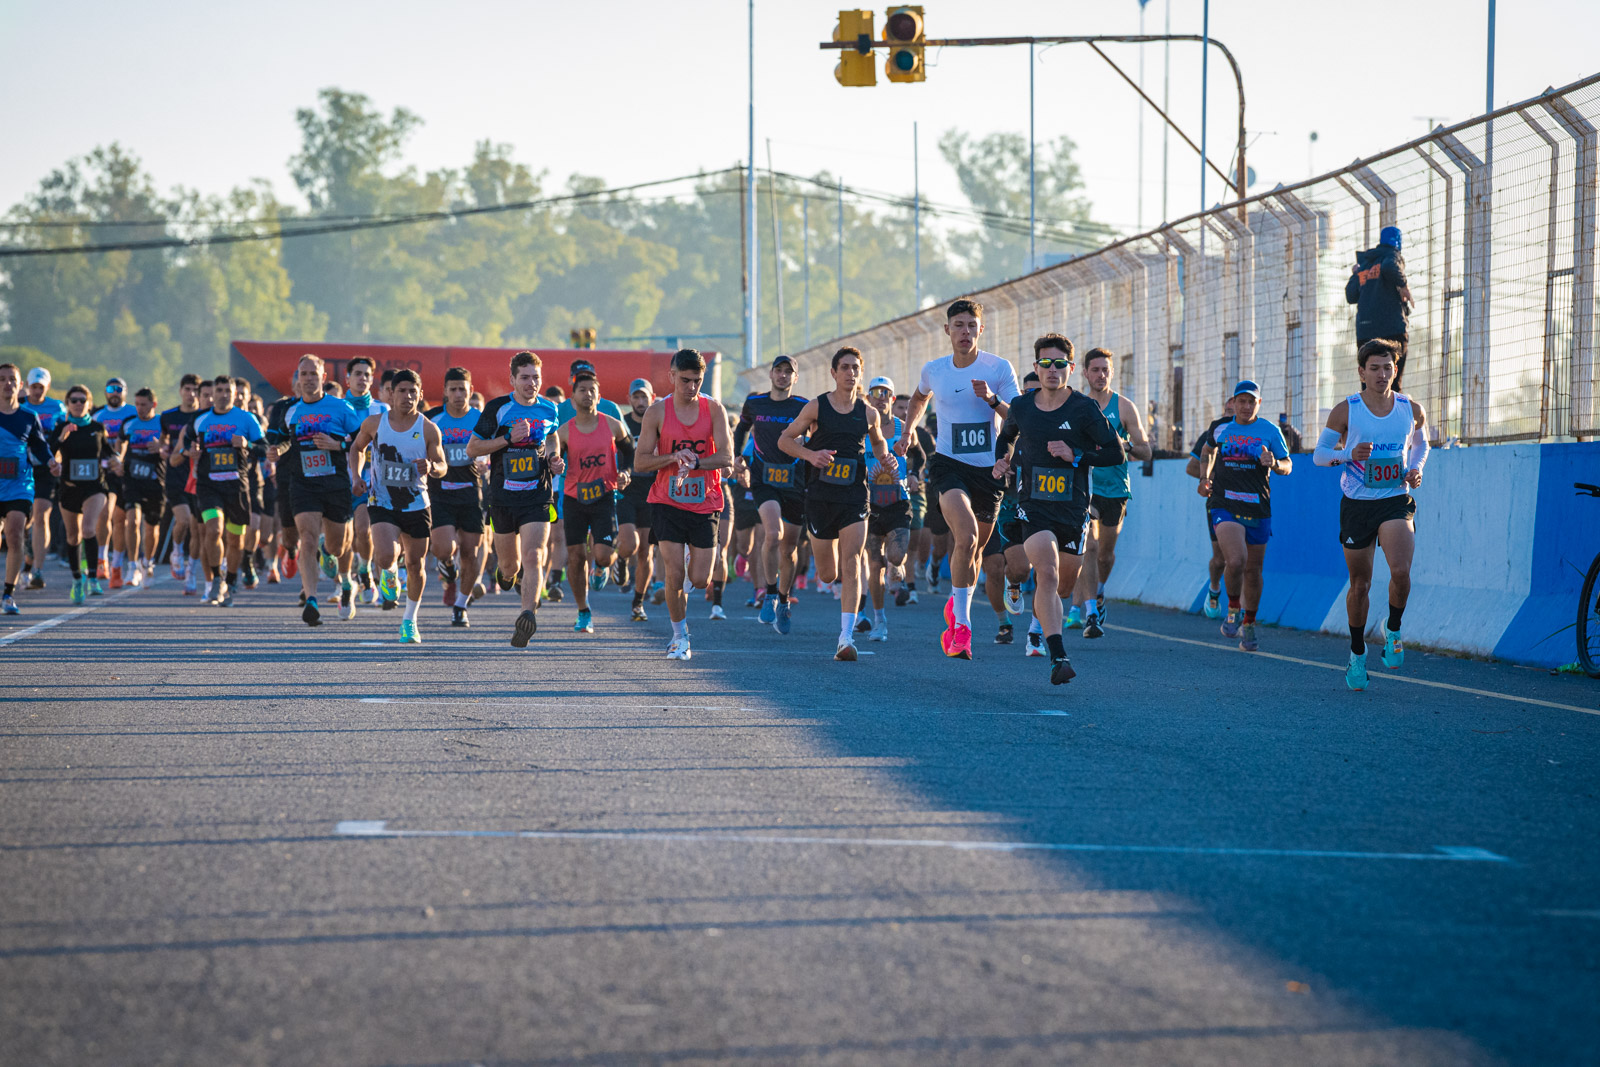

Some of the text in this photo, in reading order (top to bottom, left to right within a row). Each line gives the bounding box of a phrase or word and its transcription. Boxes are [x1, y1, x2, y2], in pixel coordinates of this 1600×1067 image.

[756, 415, 795, 423] RUNNEA
[961, 429, 985, 447] 106
[306, 454, 326, 468] 359
[450, 449, 469, 461] 105
[78, 464, 90, 476] 21
[510, 457, 533, 473] 707
[827, 462, 850, 478] 718
[1374, 464, 1400, 481] 303
[387, 467, 410, 481] 174
[768, 468, 789, 483] 782
[675, 483, 698, 497] 313
[1038, 475, 1065, 493] 706
[582, 485, 602, 500] 712
